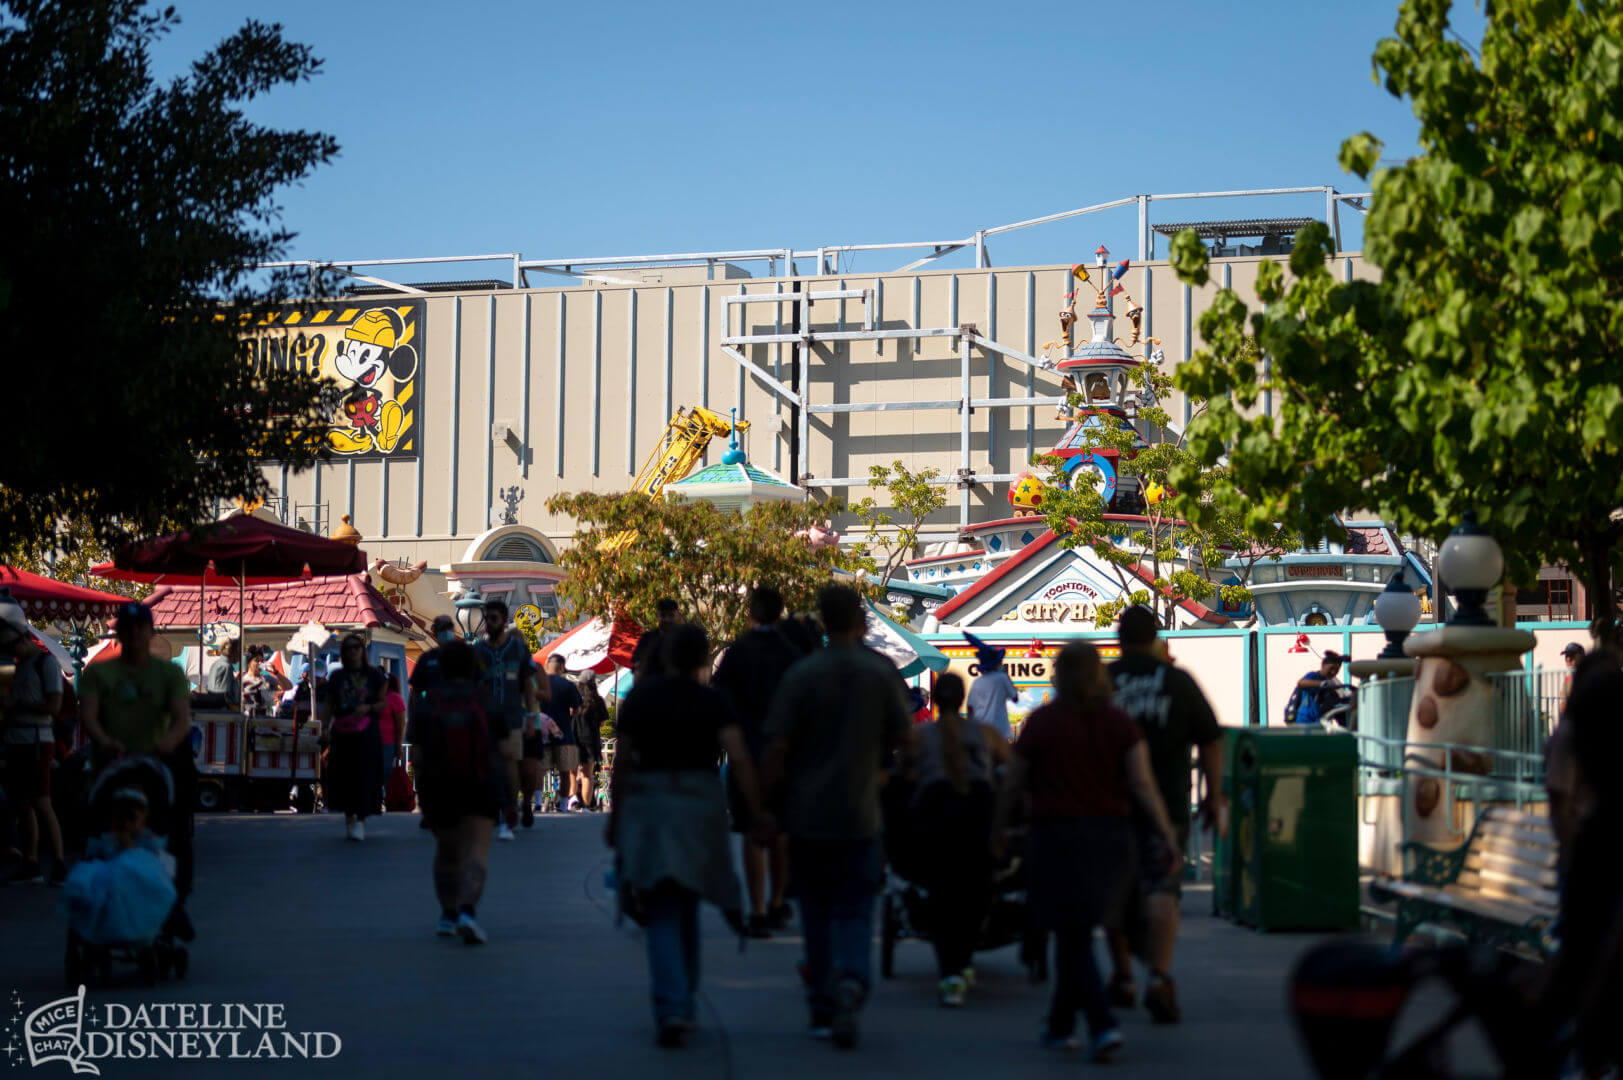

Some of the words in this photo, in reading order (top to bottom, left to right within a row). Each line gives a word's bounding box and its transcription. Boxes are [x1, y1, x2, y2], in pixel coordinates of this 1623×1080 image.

[240, 333, 326, 379] DING?
[1288, 565, 1344, 578] COURTHOUSE
[1043, 582, 1098, 600] TOONTOWN
[1021, 602, 1070, 623] CITY
[1071, 602, 1112, 622] HA
[967, 663, 1046, 677] CING
